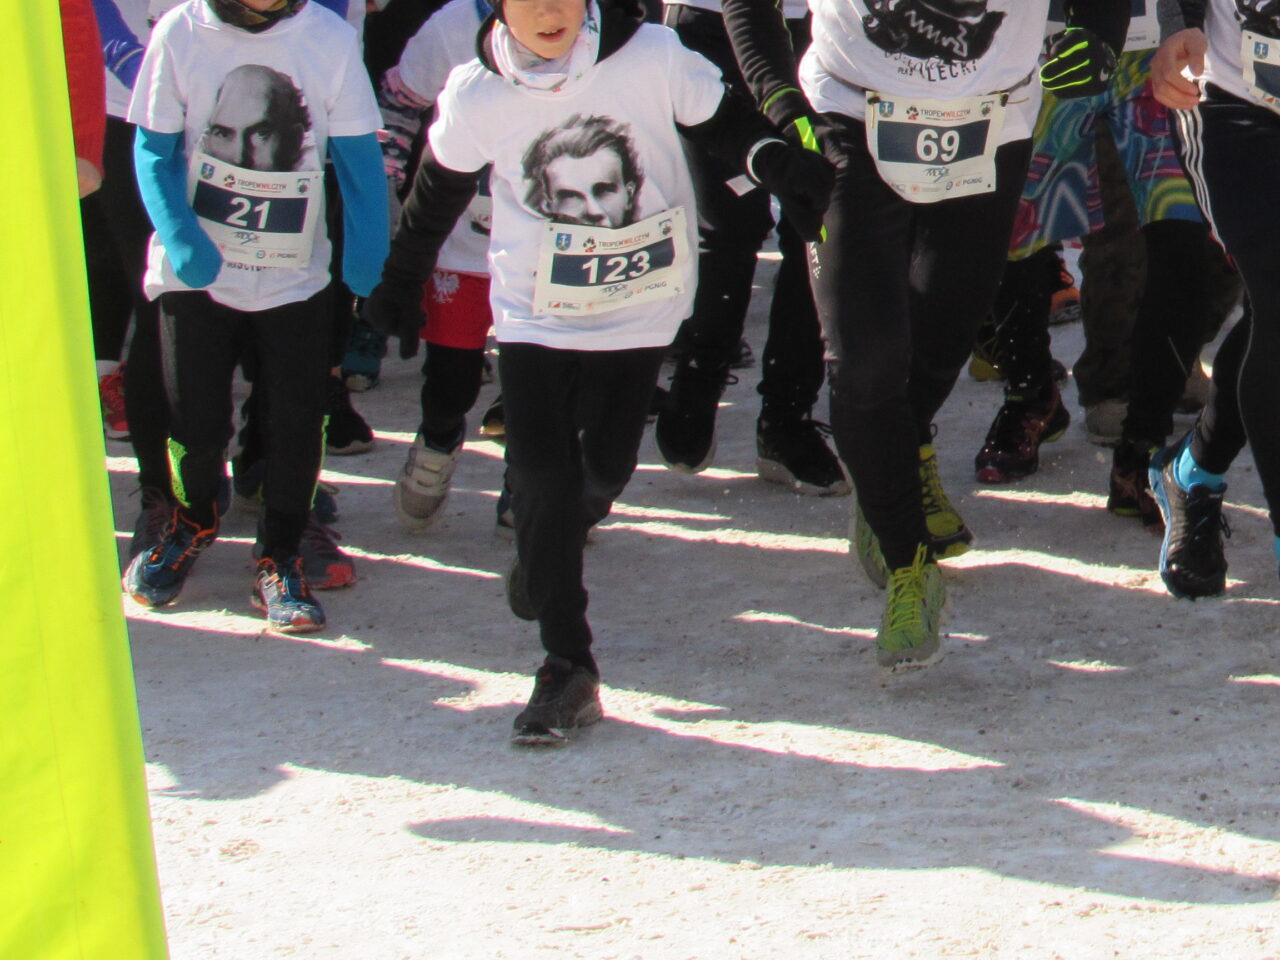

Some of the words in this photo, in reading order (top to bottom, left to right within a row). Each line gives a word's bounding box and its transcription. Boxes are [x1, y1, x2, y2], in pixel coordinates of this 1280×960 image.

[916, 128, 960, 162] 69
[225, 196, 271, 230] 21
[581, 250, 651, 284] 123
